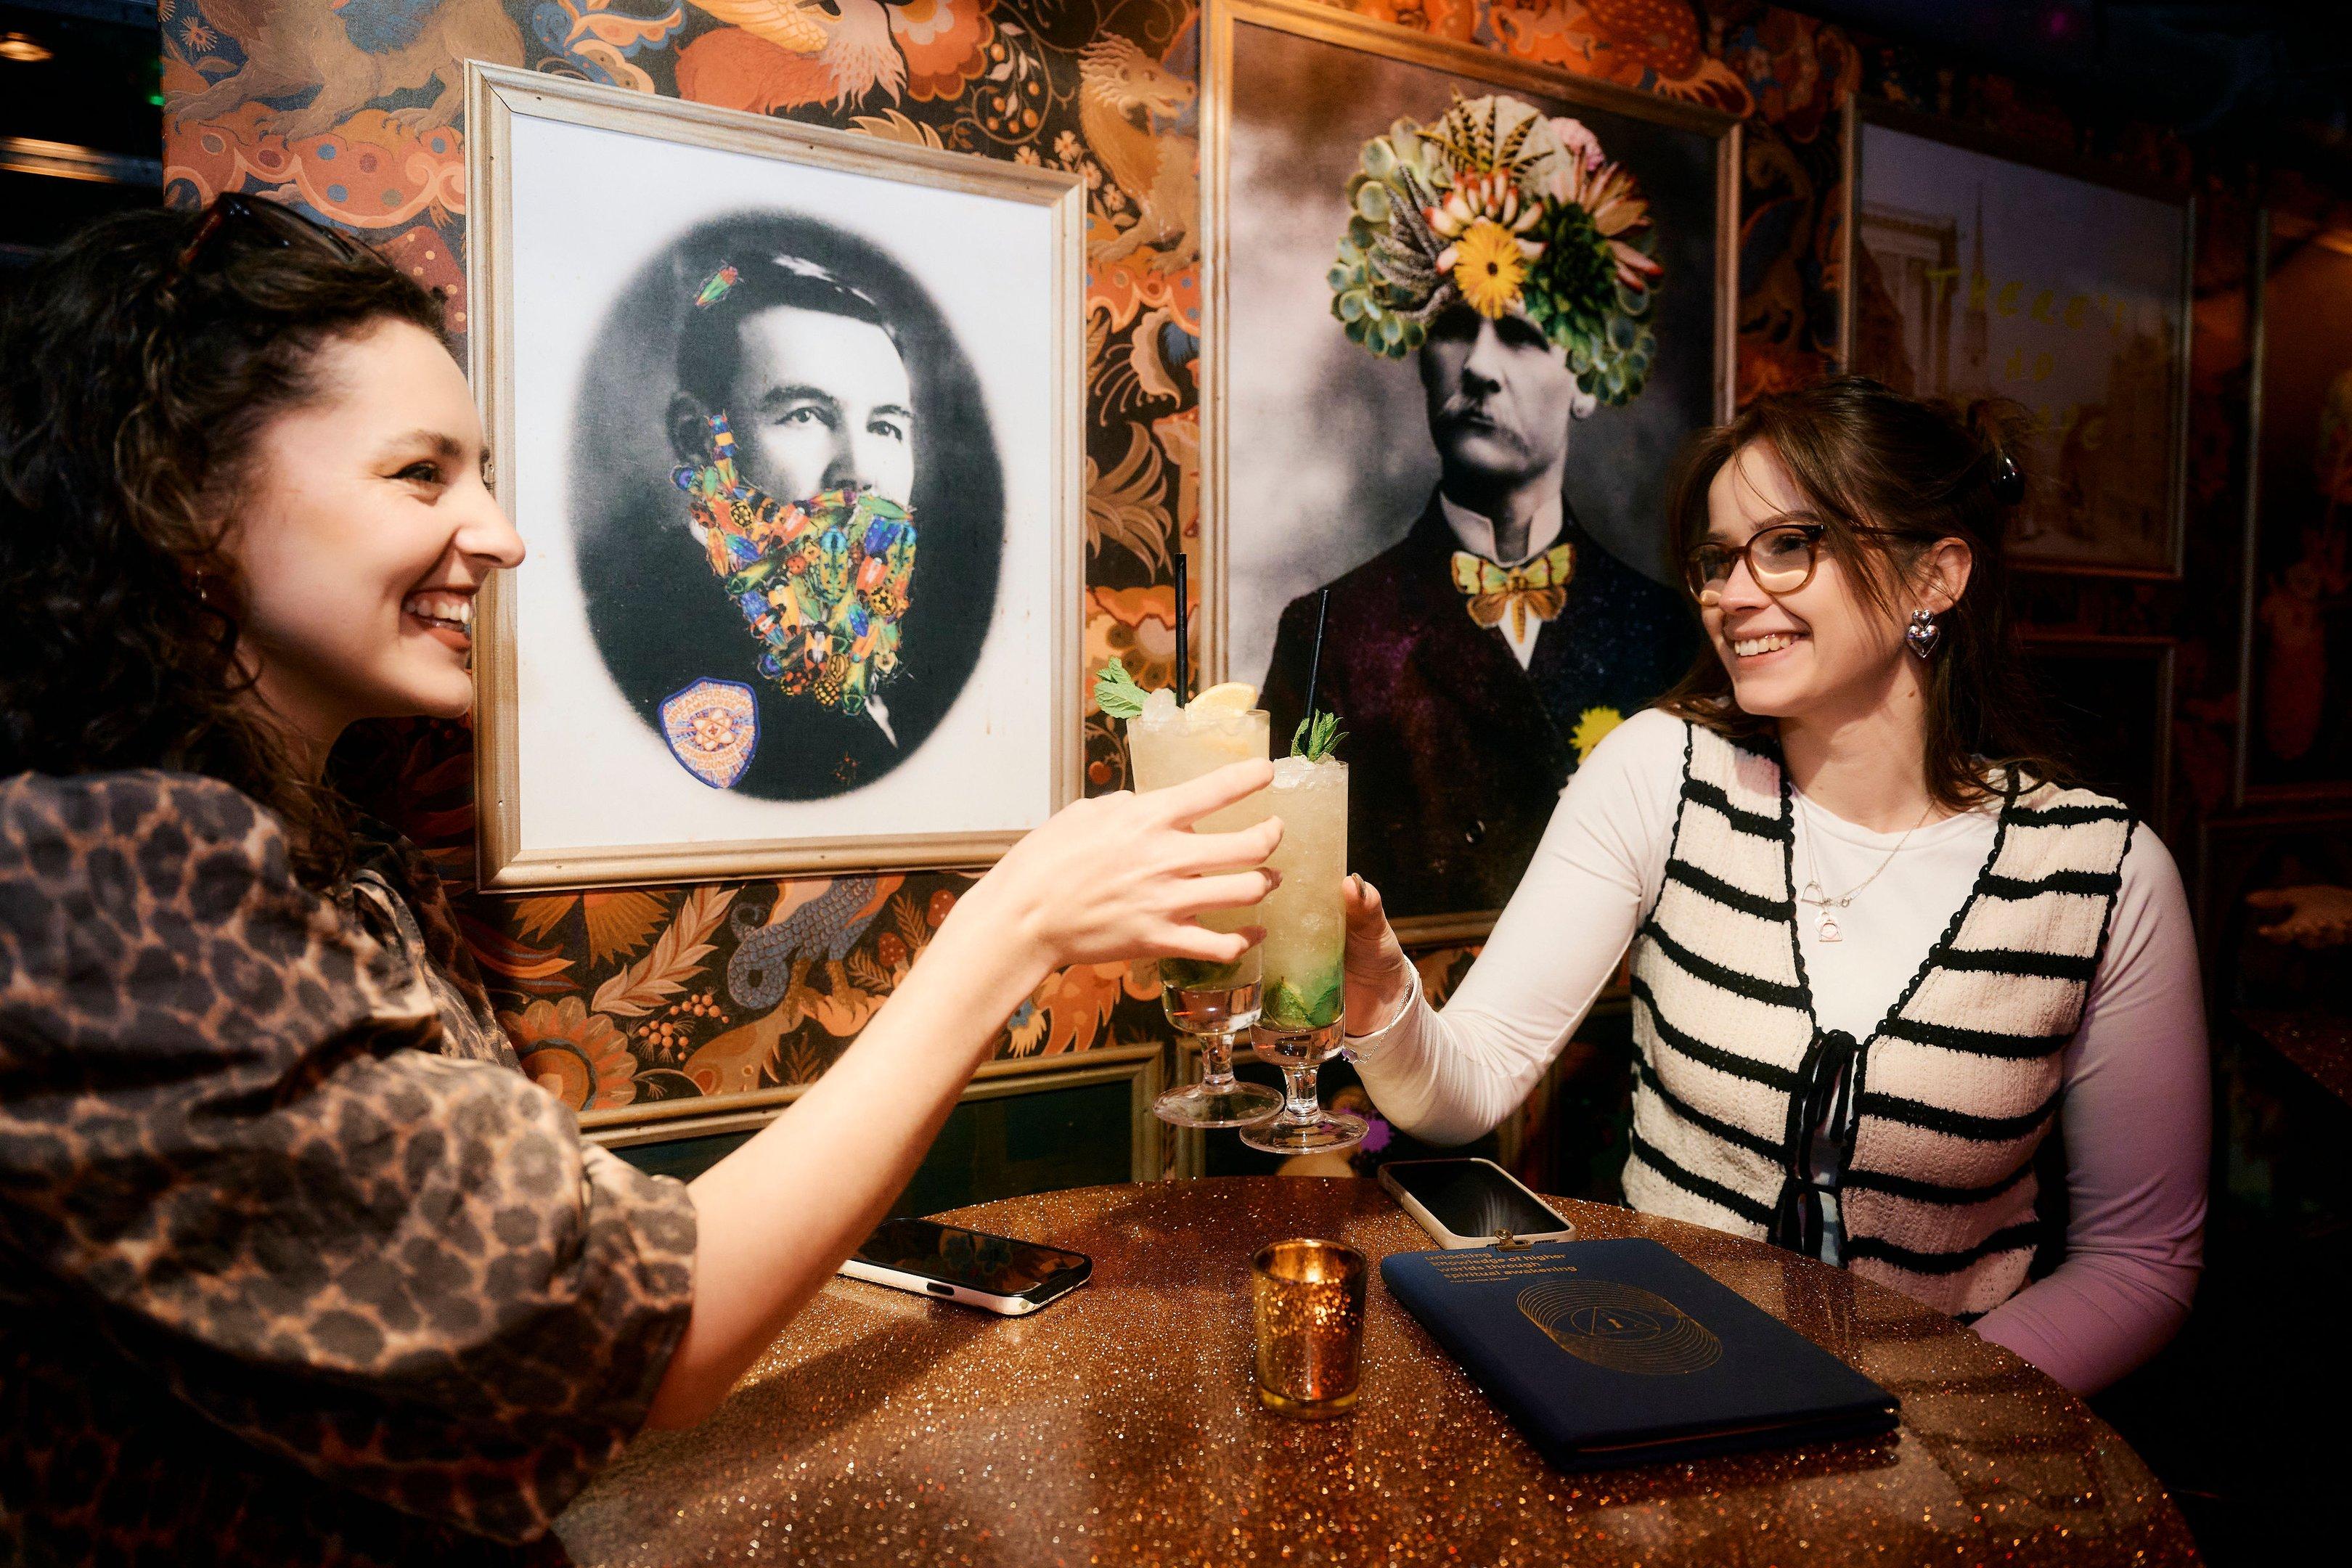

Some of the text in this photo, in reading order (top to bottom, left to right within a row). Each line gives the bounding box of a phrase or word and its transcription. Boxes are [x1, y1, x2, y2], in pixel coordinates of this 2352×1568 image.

[1430, 1257, 1506, 1266] knowledge
[1443, 1266, 1578, 1278] spiritual awakening
